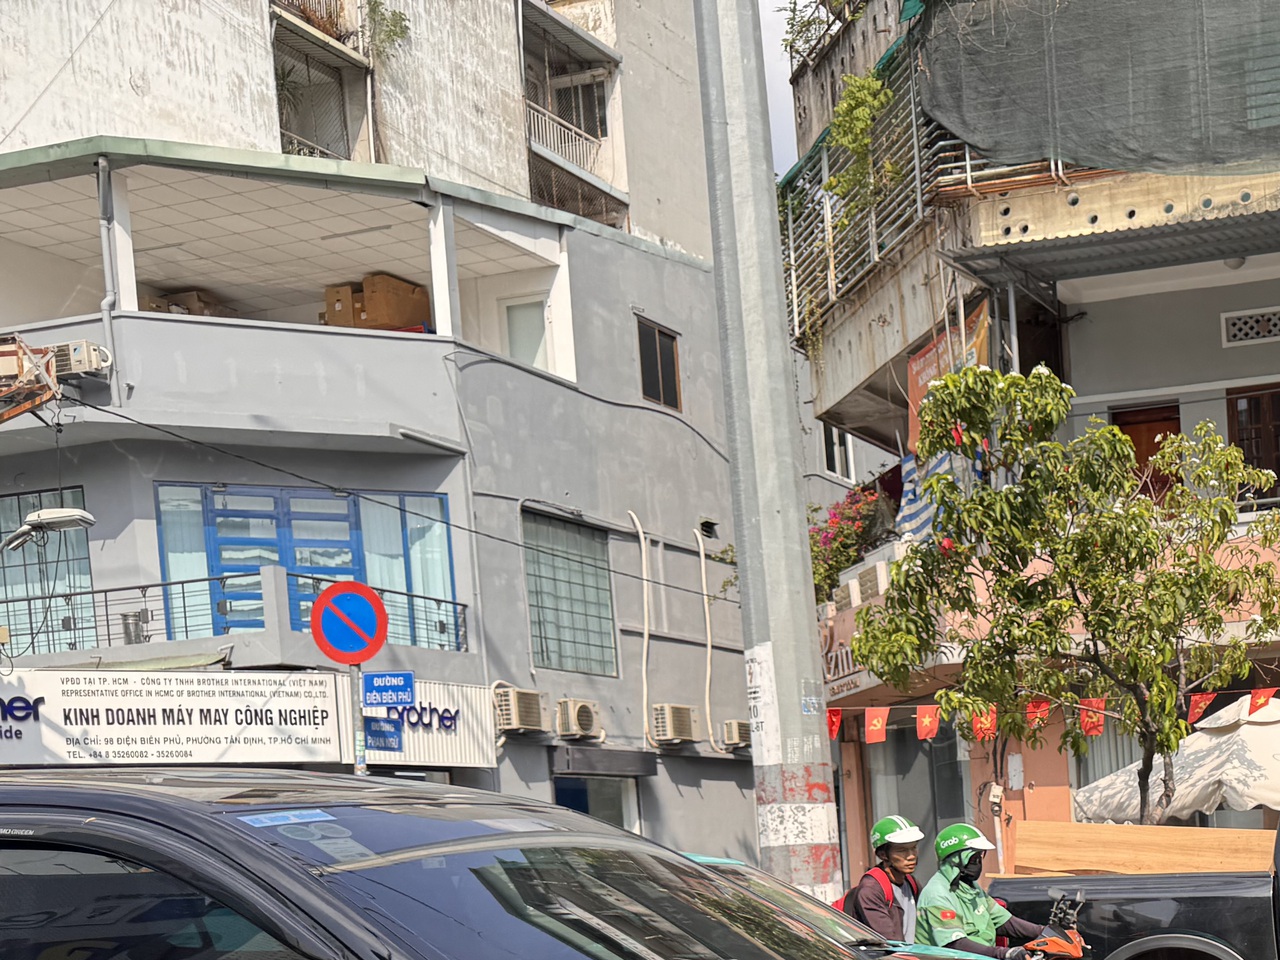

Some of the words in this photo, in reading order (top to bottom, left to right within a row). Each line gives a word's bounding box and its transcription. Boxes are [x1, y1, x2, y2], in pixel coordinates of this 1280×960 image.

[60, 677, 81, 686] VPĐD
[83, 677, 96, 687] TẠI
[98, 677, 111, 686] TP.
[112, 677, 129, 686] HCM
[140, 676, 161, 686] CÔNG
[163, 678, 173, 686] TY
[175, 678, 195, 686] TNHH
[197, 678, 229, 686] BROTHER
[231, 679, 287, 687] INTERNATIONAL
[308, 679, 328, 688] NAM)
[373, 675, 404, 687] ĐƯỜNG
[61, 689, 119, 697] REPRESENTATIVE
[121, 689, 144, 697] OFFICE
[145, 689, 153, 697] IN
[155, 690, 175, 698] HCMC
[176, 690, 185, 698] OF
[187, 690, 216, 698] BROTHER
[218, 690, 267, 698] INTERNATIONAL
[269, 690, 302, 699] (VIETNAM)
[382, 689, 397, 703] BIÊN
[398, 687, 412, 702] PHỦ
[63, 708, 101, 726] KINH
[105, 708, 157, 726] DOANH
[161, 704, 194, 726] MÁY
[199, 708, 229, 726] MAY
[235, 704, 274, 726] CÔNG
[278, 705, 329, 730] NGHIỆP
[66, 737, 81, 747] ĐỊA
[104, 737, 114, 745] 98
[116, 735, 137, 746] ĐIỆN
[140, 735, 161, 745] BIÊN
[163, 734, 184, 746] PHỦ,
[186, 735, 222, 745] PHƯỜNG
[224, 735, 241, 745] TÂN
[243, 736, 266, 747] ĐỊNH,
[294, 734, 309, 745] CHÍ
[310, 736, 332, 745] MINH
[67, 750, 86, 759] TEL.
[89, 751, 102, 759] +84
[112, 750, 149, 759] 35260082
[156, 750, 193, 758] 35260084
[940, 837, 959, 849] Grab
